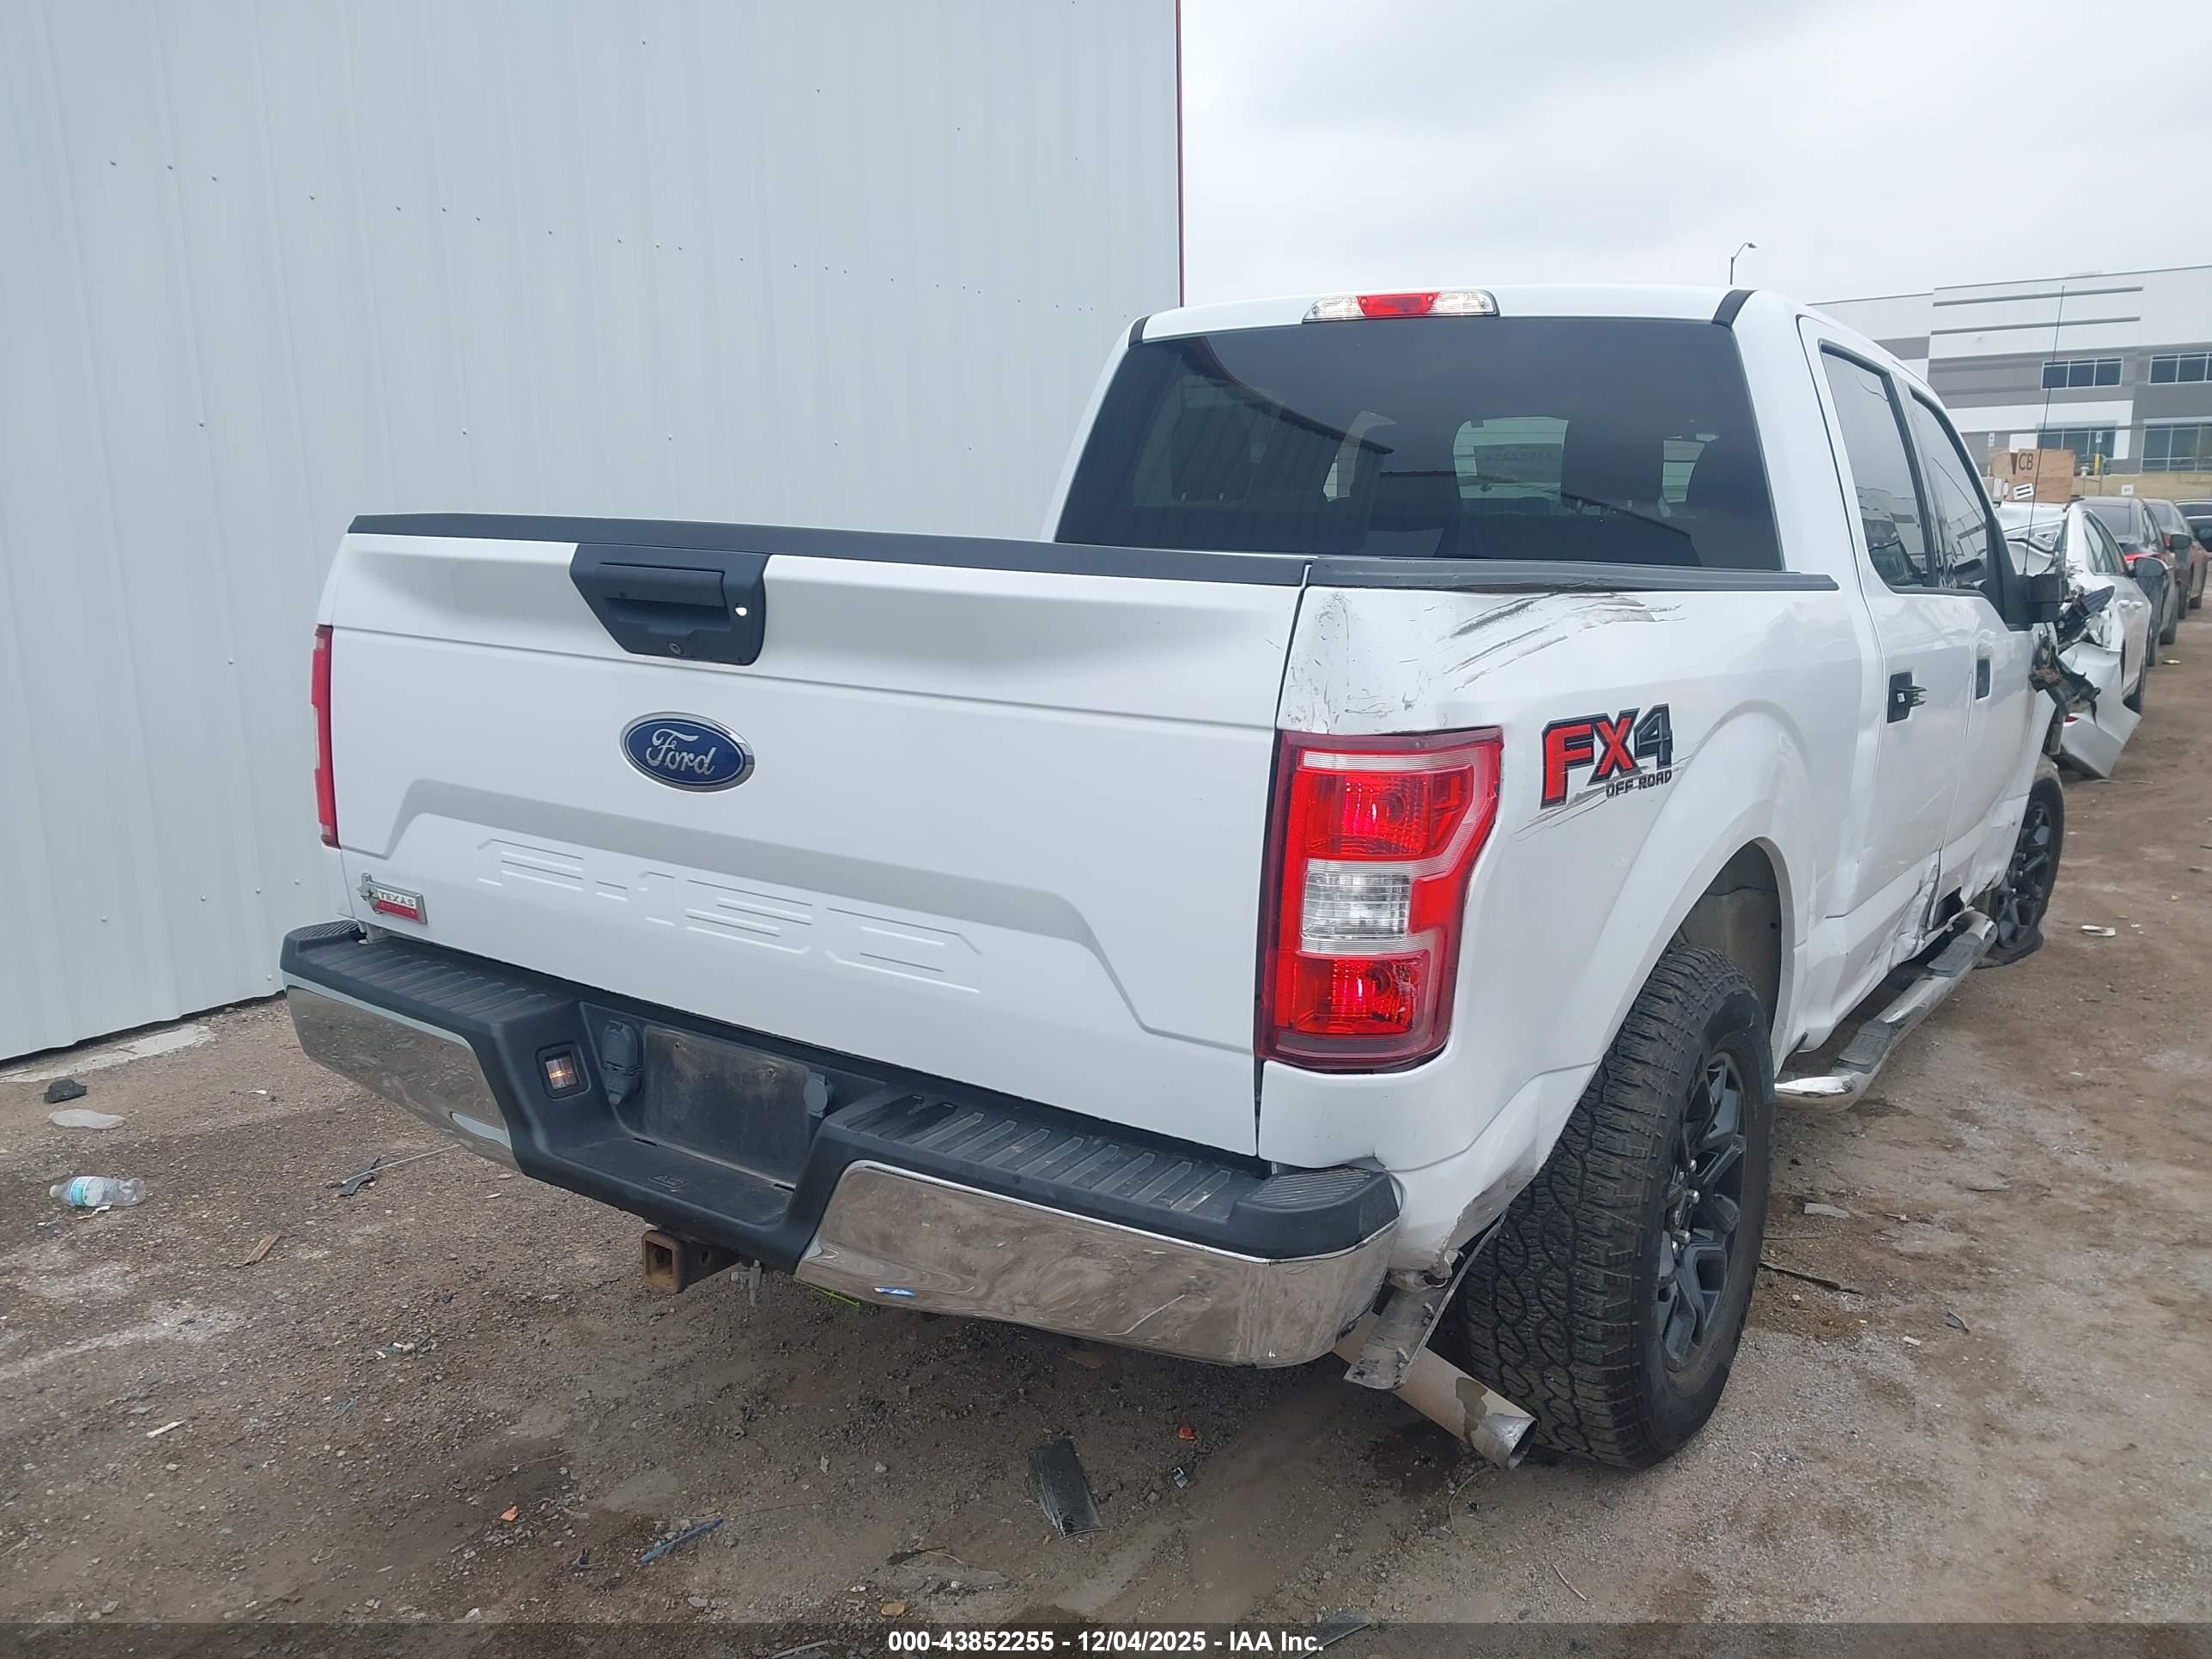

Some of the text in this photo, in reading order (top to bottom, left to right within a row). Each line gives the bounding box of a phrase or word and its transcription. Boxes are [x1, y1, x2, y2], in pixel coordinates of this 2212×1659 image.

[2019, 453, 2034, 471] CB
[646, 728, 717, 775] Ford
[1540, 702, 1674, 810] FX4
[380, 892, 414, 908] TEXAS
